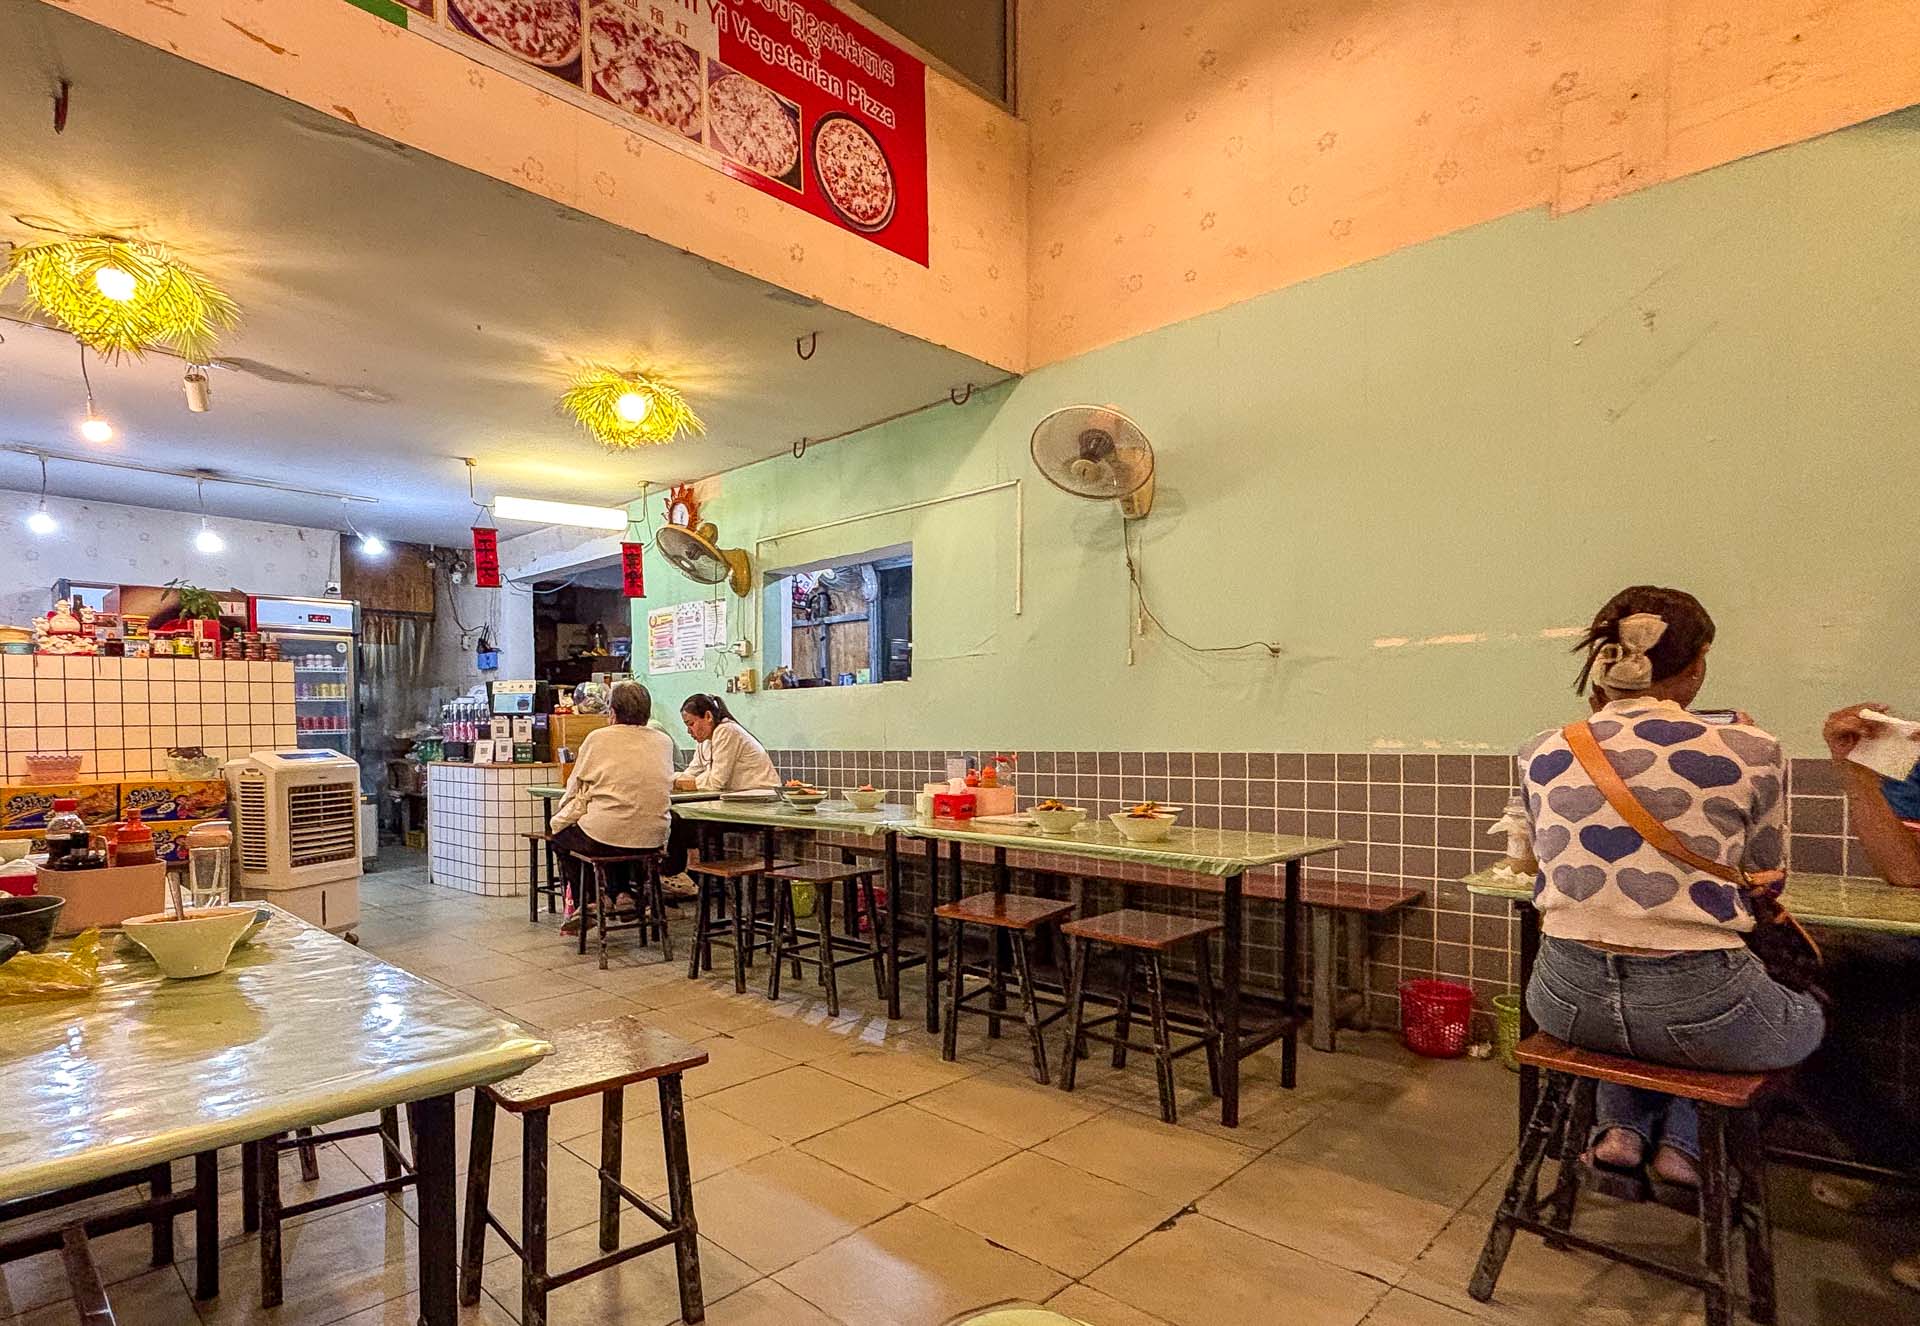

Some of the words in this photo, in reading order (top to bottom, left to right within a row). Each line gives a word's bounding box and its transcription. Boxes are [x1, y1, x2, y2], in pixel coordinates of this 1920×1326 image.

[704, 0, 728, 33] Yi
[731, 10, 844, 99] Vegetarian
[846, 79, 896, 130] Pizza
